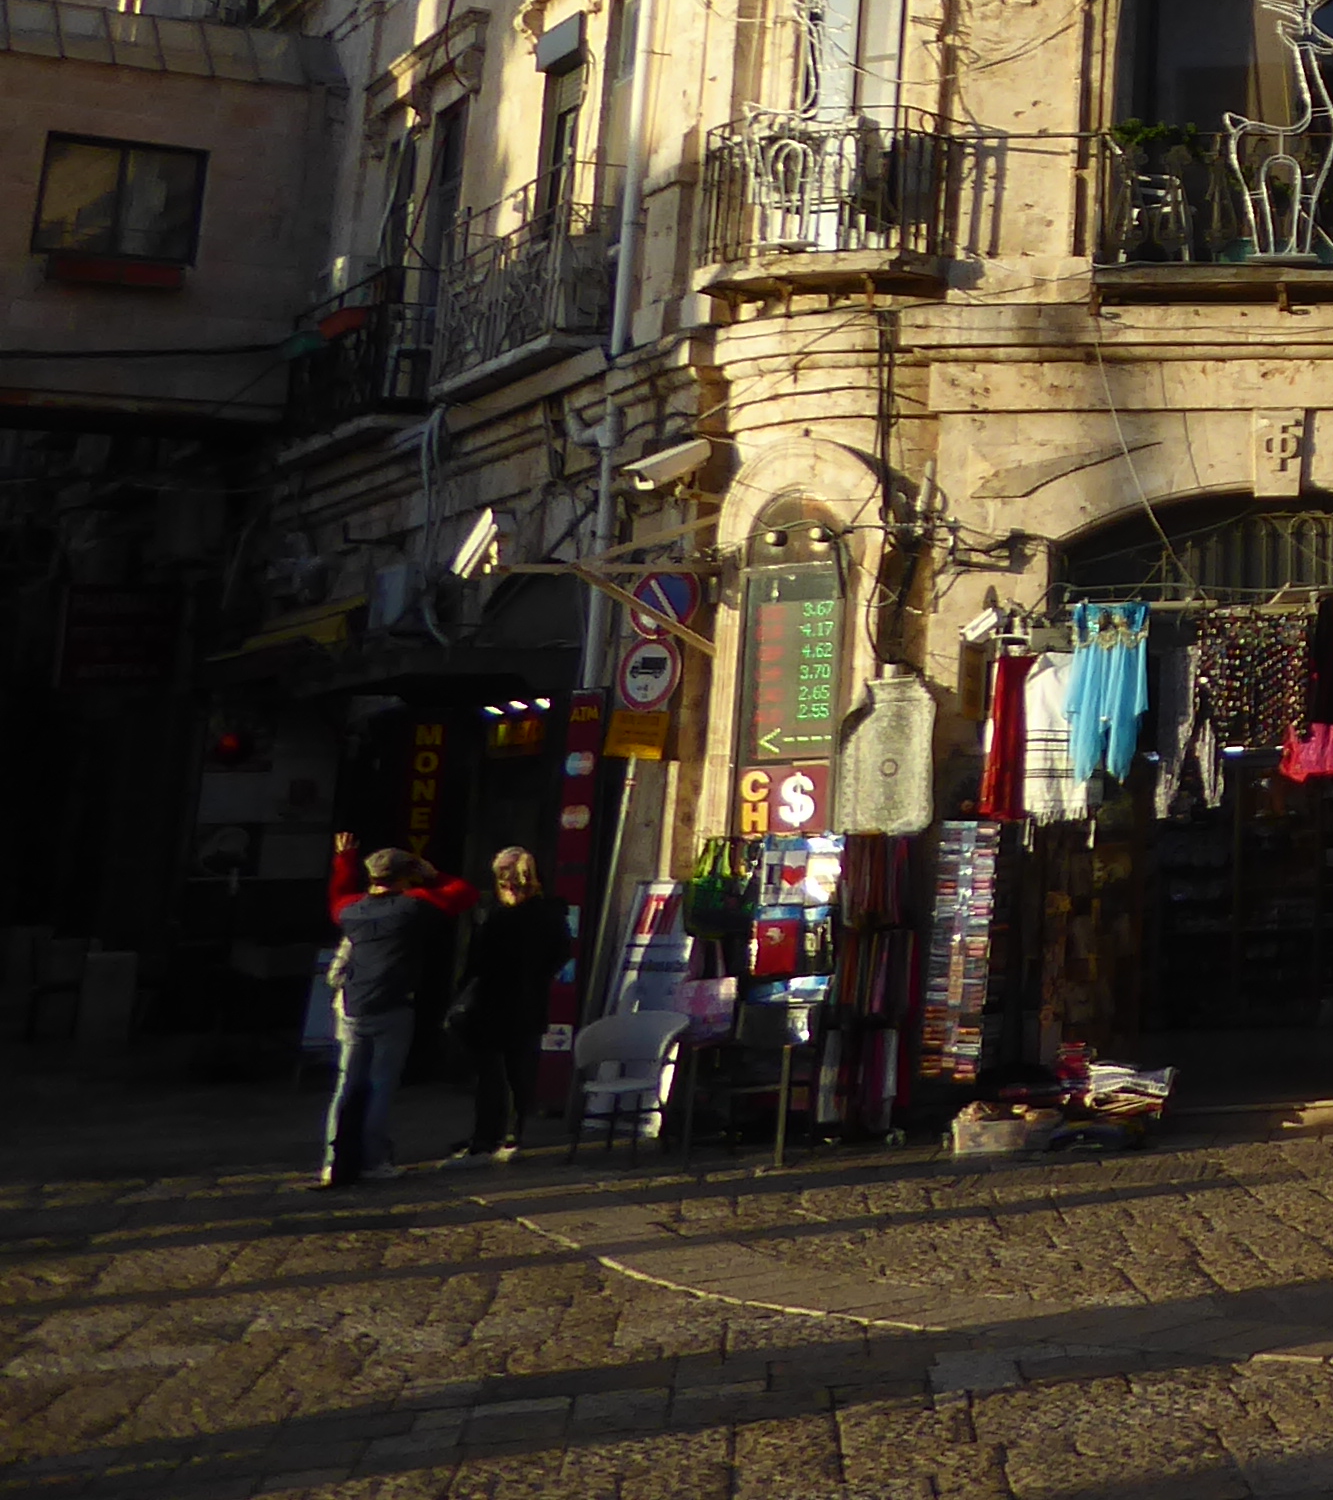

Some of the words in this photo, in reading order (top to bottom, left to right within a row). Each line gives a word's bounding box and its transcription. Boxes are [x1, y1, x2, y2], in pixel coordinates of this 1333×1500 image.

[802, 601, 835, 618] 3.67
[801, 642, 834, 658] 4.62
[798, 663, 831, 679] 3.70
[798, 684, 830, 700] 2.65
[569, 705, 601, 724] ATM
[796, 704, 830, 718] 2.55
[407, 723, 445, 856] MONEY
